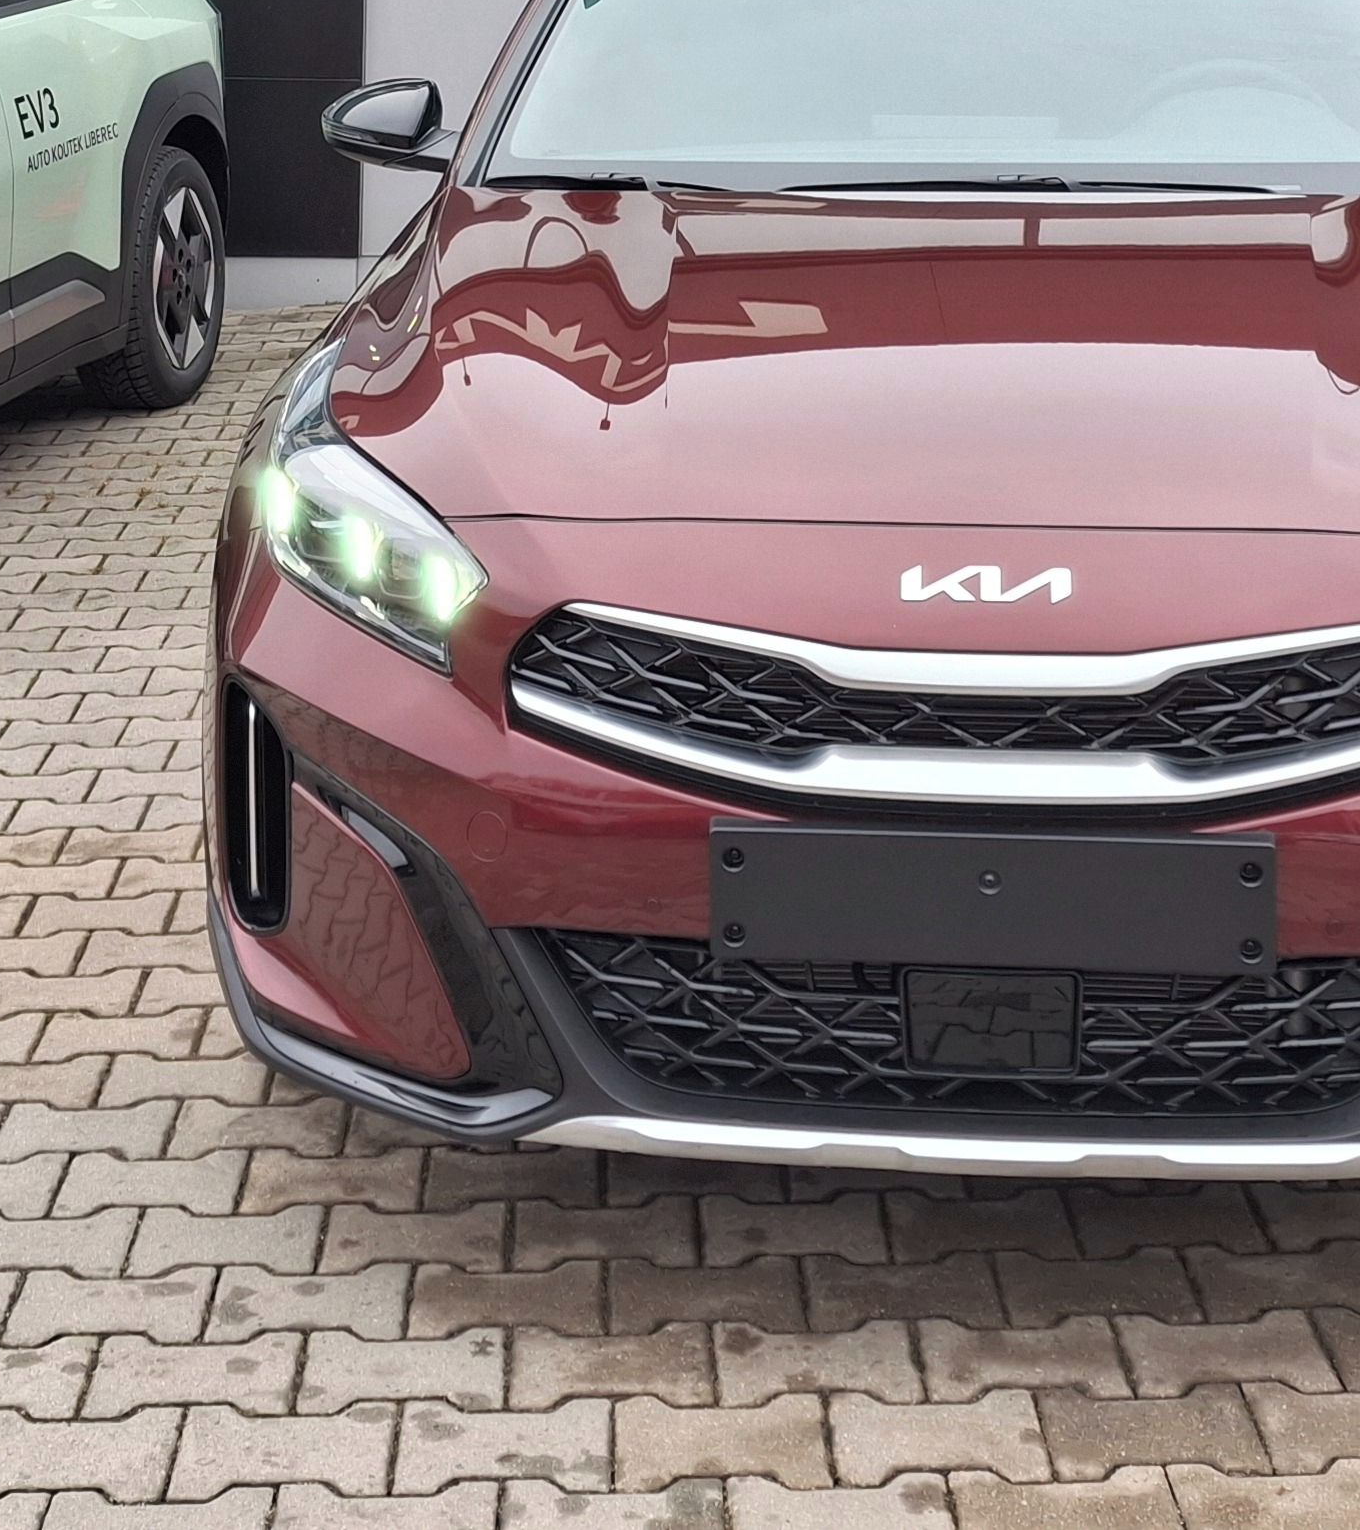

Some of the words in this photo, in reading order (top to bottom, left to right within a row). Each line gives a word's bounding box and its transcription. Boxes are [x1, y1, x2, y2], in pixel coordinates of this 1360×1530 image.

[14, 87, 60, 140] EV3
[27, 149, 51, 174] AUTO
[51, 134, 84, 163] KOUTEK
[84, 122, 119, 149] LIBEREC
[899, 563, 1073, 605] KIA
